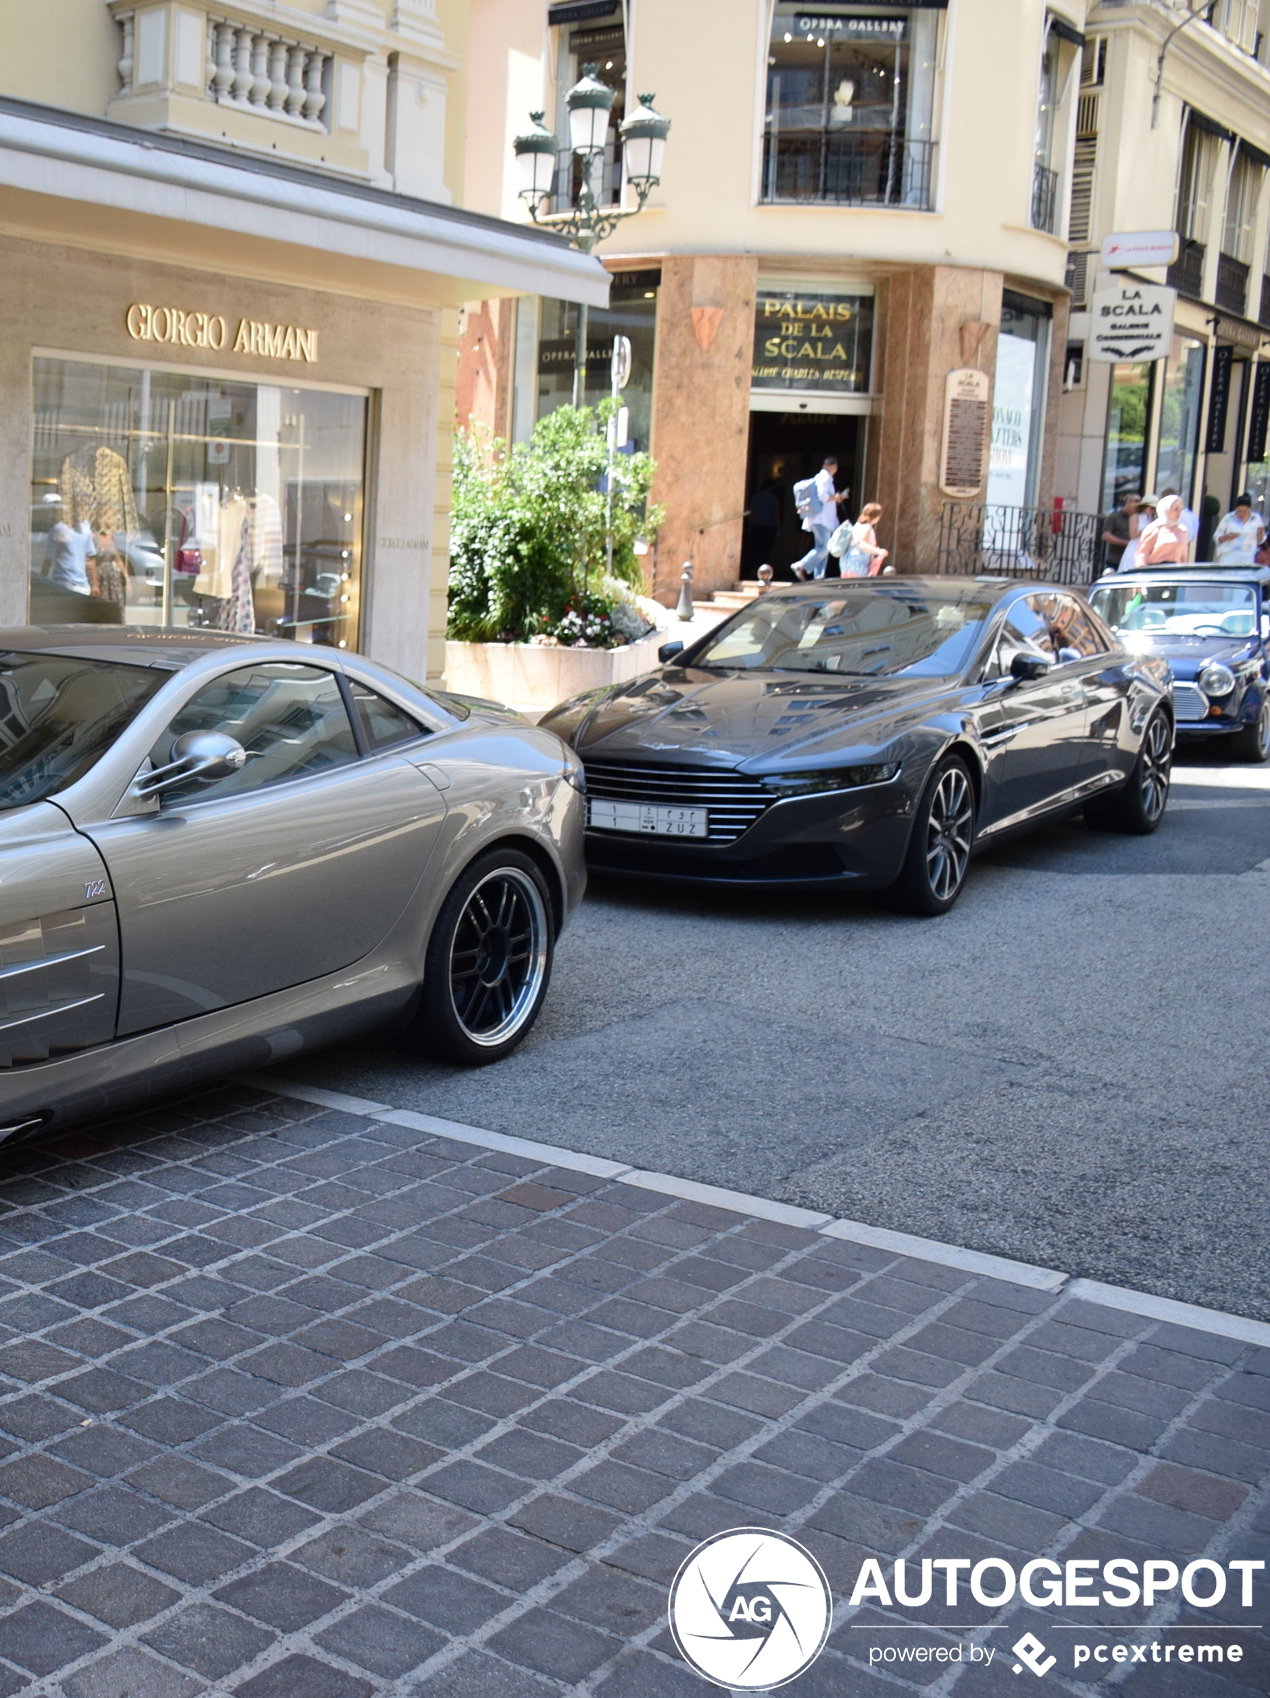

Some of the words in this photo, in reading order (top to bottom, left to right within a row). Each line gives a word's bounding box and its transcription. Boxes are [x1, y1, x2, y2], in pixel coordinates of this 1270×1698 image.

[800, 17, 843, 31] OPERA
[849, 19, 906, 32] GALLERY
[1122, 290, 1142, 300] LA
[764, 299, 851, 320] PALAIS
[1101, 303, 1162, 317] SCALA
[127, 303, 227, 350] GIORGIO
[233, 318, 319, 363] ARMANI
[781, 322, 803, 336] DE
[811, 323, 833, 338] LA
[542, 351, 576, 363] OPERA
[764, 339, 848, 360] SCALA
[84, 879, 106, 899] 722
